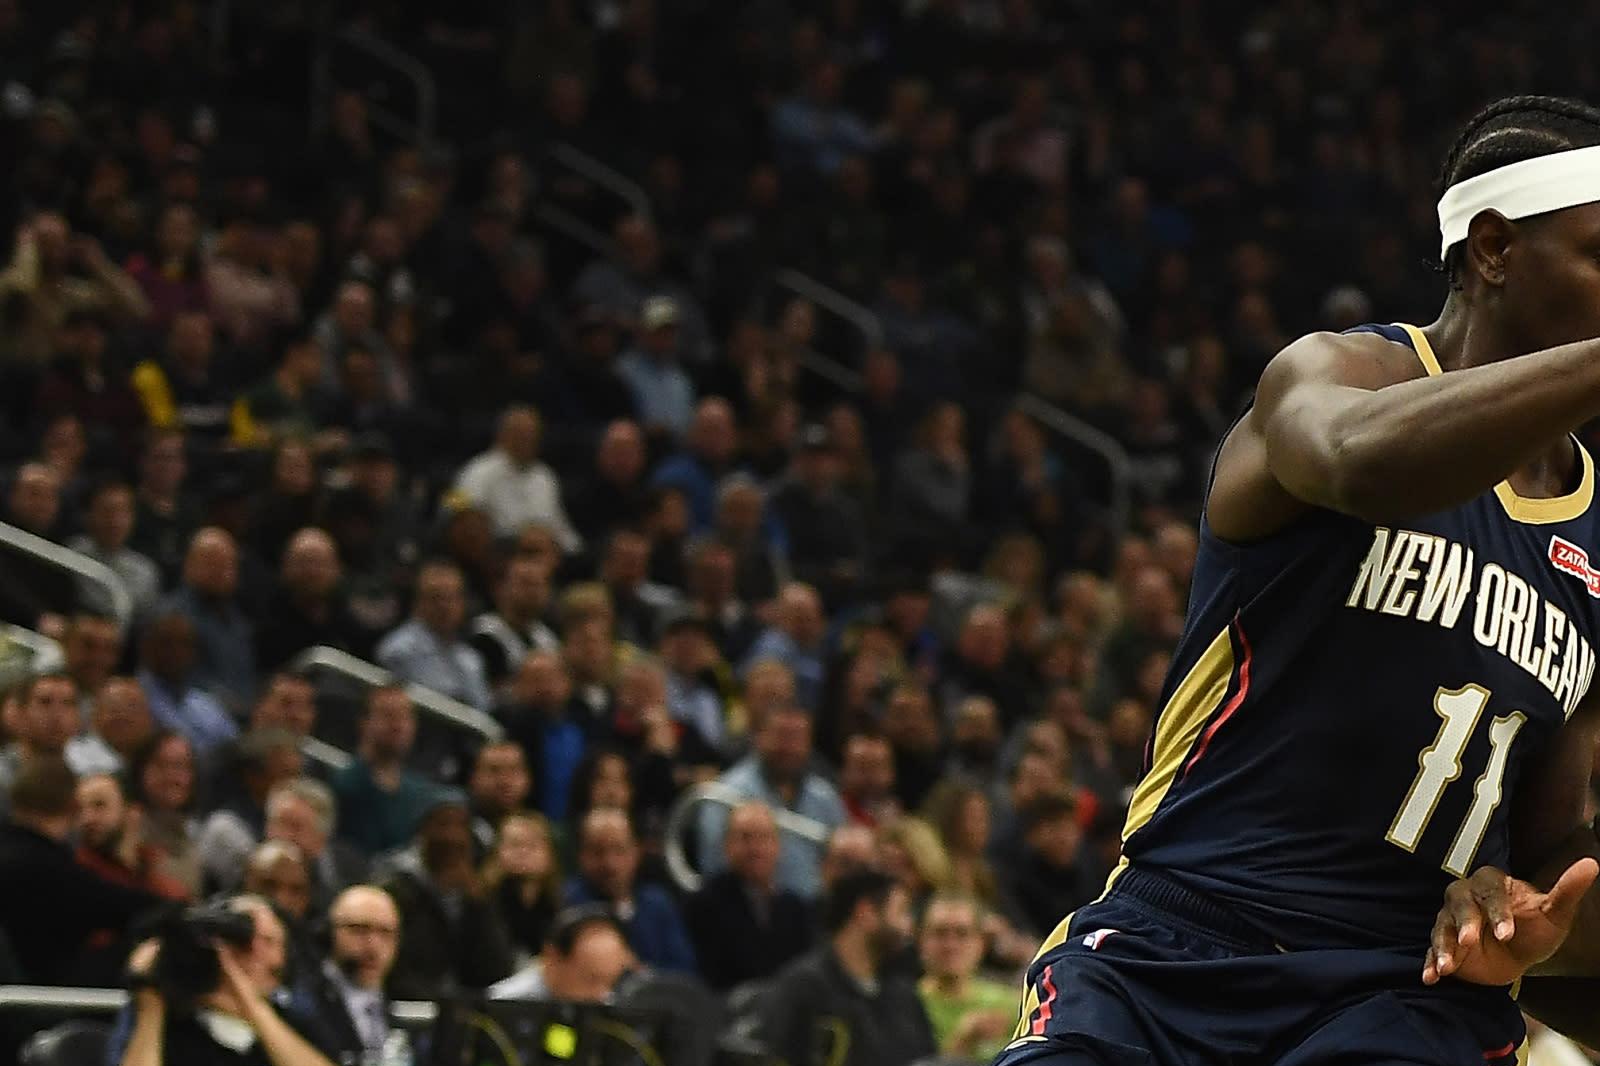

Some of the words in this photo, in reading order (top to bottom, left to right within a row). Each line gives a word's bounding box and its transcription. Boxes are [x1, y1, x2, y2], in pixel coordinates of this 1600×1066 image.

[1346, 527, 1474, 629] NEW
[1473, 562, 1597, 725] ORLEAN
[1385, 683, 1528, 879] 11
